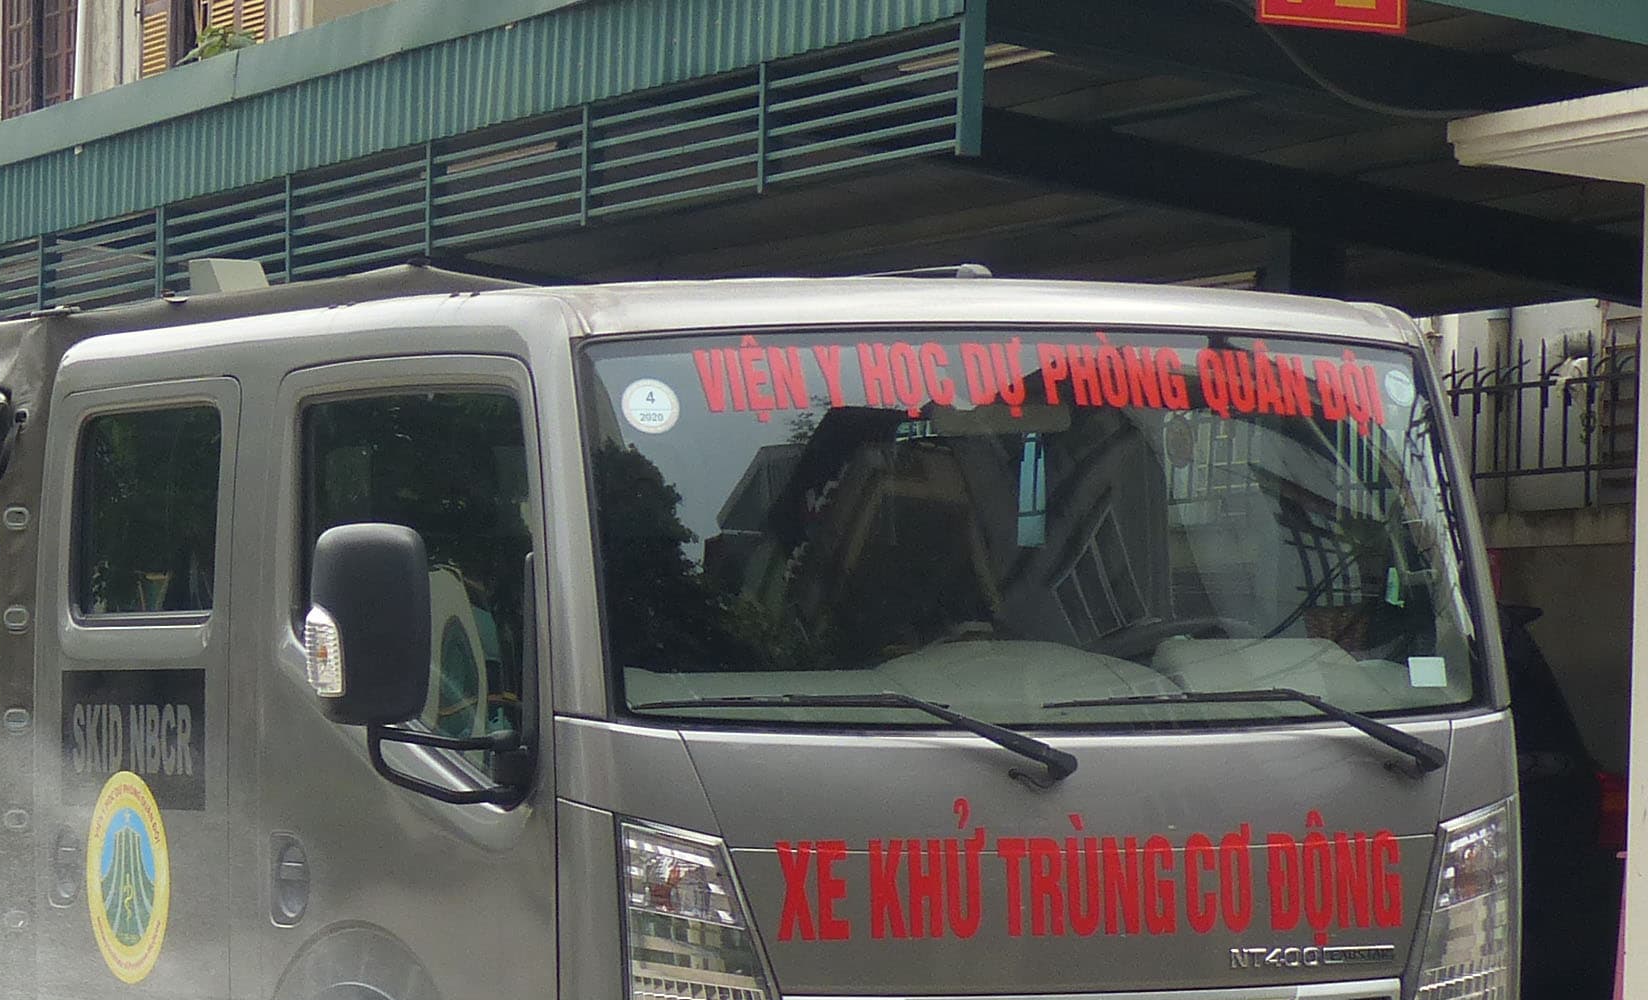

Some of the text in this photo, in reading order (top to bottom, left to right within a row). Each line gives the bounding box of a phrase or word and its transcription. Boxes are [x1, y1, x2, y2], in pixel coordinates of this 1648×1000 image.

[646, 391, 656, 405] 4
[693, 331, 1385, 437] VIỆN Y HỌC DỰ PHÒNG QUÂN ĐỘI
[639, 413, 664, 422] 2020
[72, 703, 193, 777] SKID NBCR
[774, 797, 1404, 946] XE KHỬ TRÙNG CƠ ĐỘNG
[1229, 946, 1319, 968] NT400
